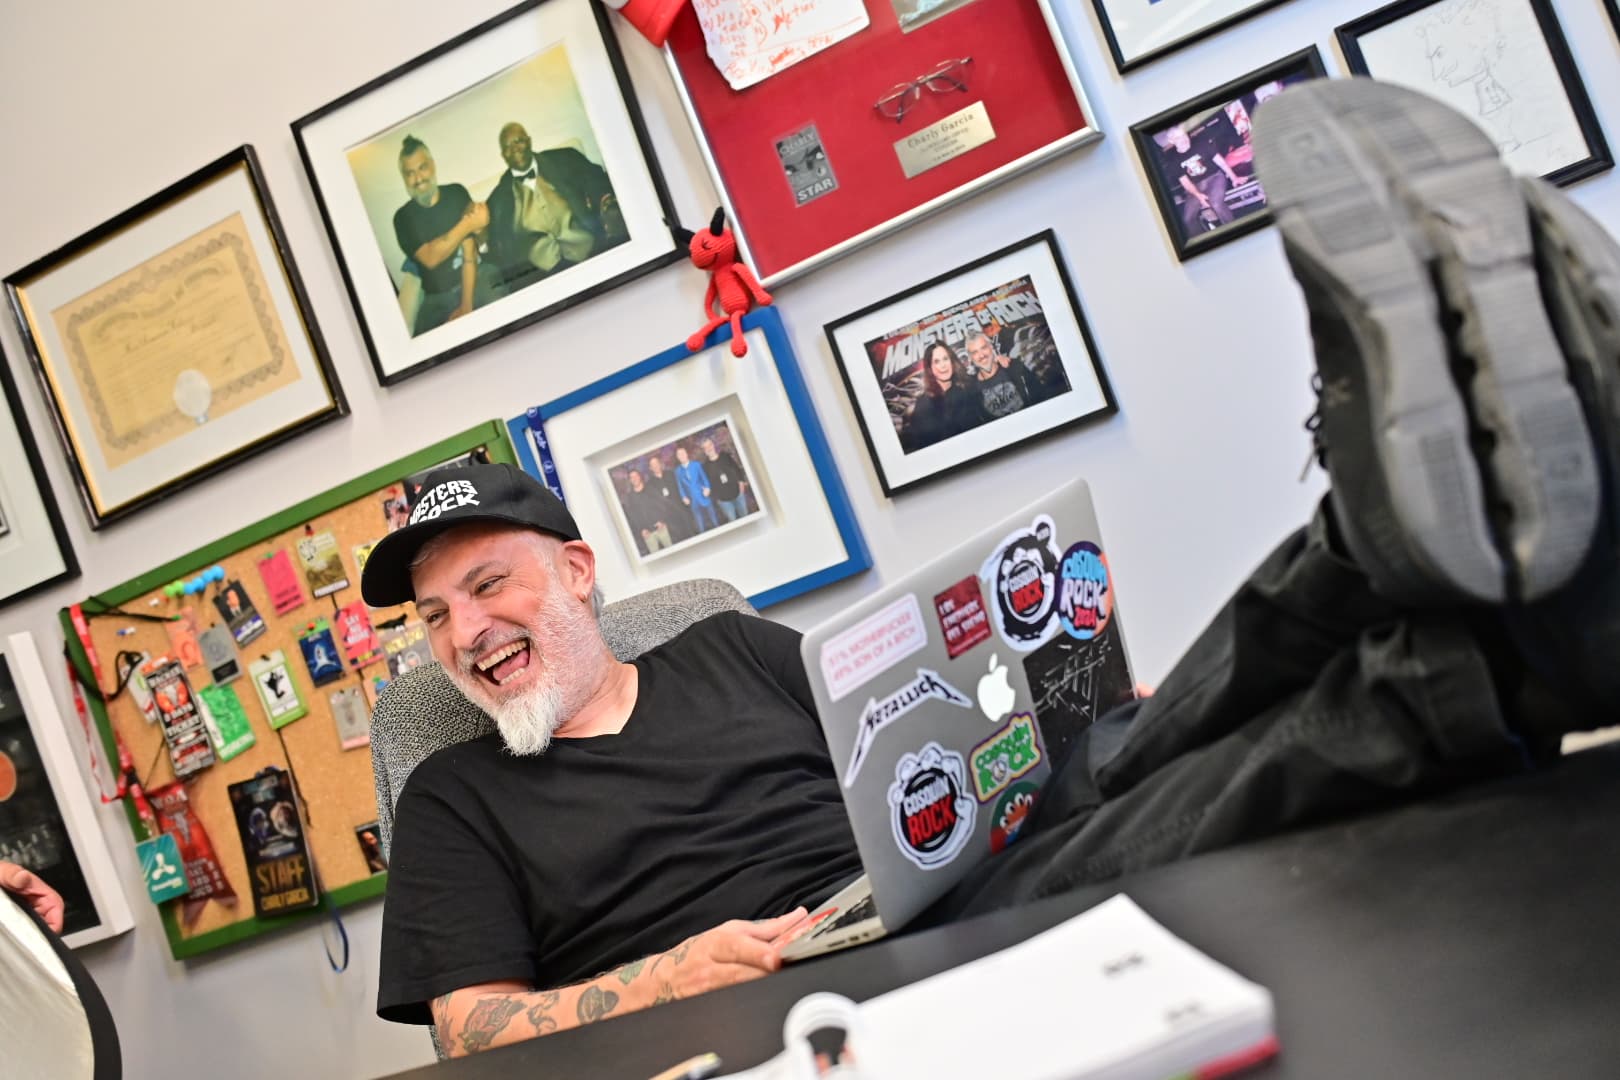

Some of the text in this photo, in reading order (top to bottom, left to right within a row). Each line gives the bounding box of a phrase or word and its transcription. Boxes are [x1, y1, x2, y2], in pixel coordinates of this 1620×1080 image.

[907, 128, 939, 149] Charly
[798, 178, 833, 201] STAR
[882, 309, 983, 380] MONSTERS
[976, 308, 994, 325] OF
[986, 290, 1043, 326] ROCK
[1059, 578, 1107, 620] ROCK
[906, 793, 957, 848] ROCK
[255, 853, 306, 894] STAFF
